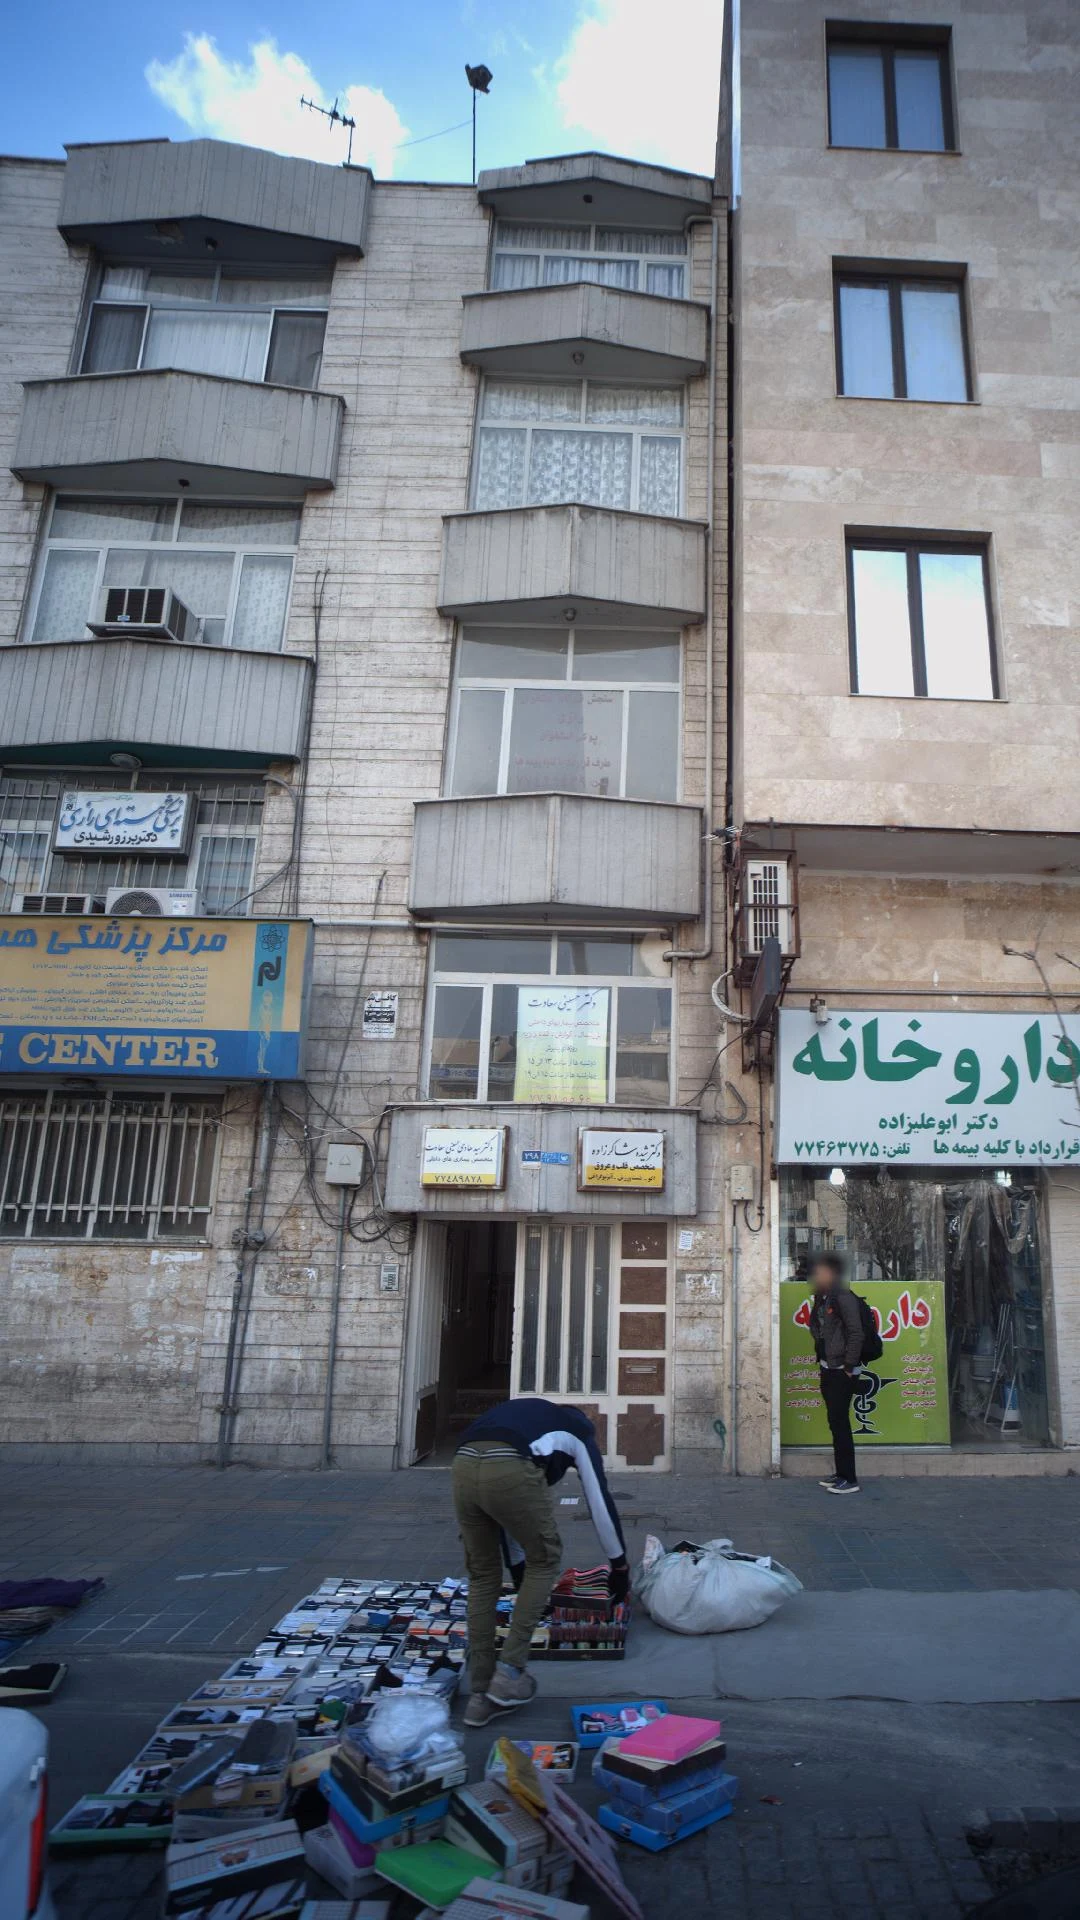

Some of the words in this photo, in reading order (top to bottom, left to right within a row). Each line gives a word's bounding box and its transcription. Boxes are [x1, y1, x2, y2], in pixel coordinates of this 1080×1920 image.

[60, 801, 96, 832] رازی
[137, 829, 158, 845] دکتر
[46, 920, 154, 962] پزشکی
[159, 927, 228, 953] مرکز
[528, 998, 558, 1007] سعادت
[577, 988, 602, 1012] دکتر
[19, 1032, 220, 1070] CENTER
[791, 1017, 1080, 1105] داروخانه
[878, 1112, 957, 1135] ابوعلیزاده
[962, 1113, 999, 1135] دکتر
[479, 1134, 498, 1154] دکتر
[646, 1140, 663, 1161] دکتر
[794, 1140, 879, 1157] ۷۷۴۶۳۷۷۵
[882, 1141, 910, 1158] تلفن:
[933, 1139, 951, 1155] ها
[952, 1141, 980, 1158] بیمه
[982, 1139, 1011, 1158] کلیه
[1015, 1139, 1026, 1156] با
[1028, 1138, 1080, 1160] قرارداد
[524, 1152, 540, 1160] ۲۹۸
[594, 1161, 611, 1171] عروق
[616, 1162, 629, 1170] قلب
[629, 1163, 656, 1172] متخصص
